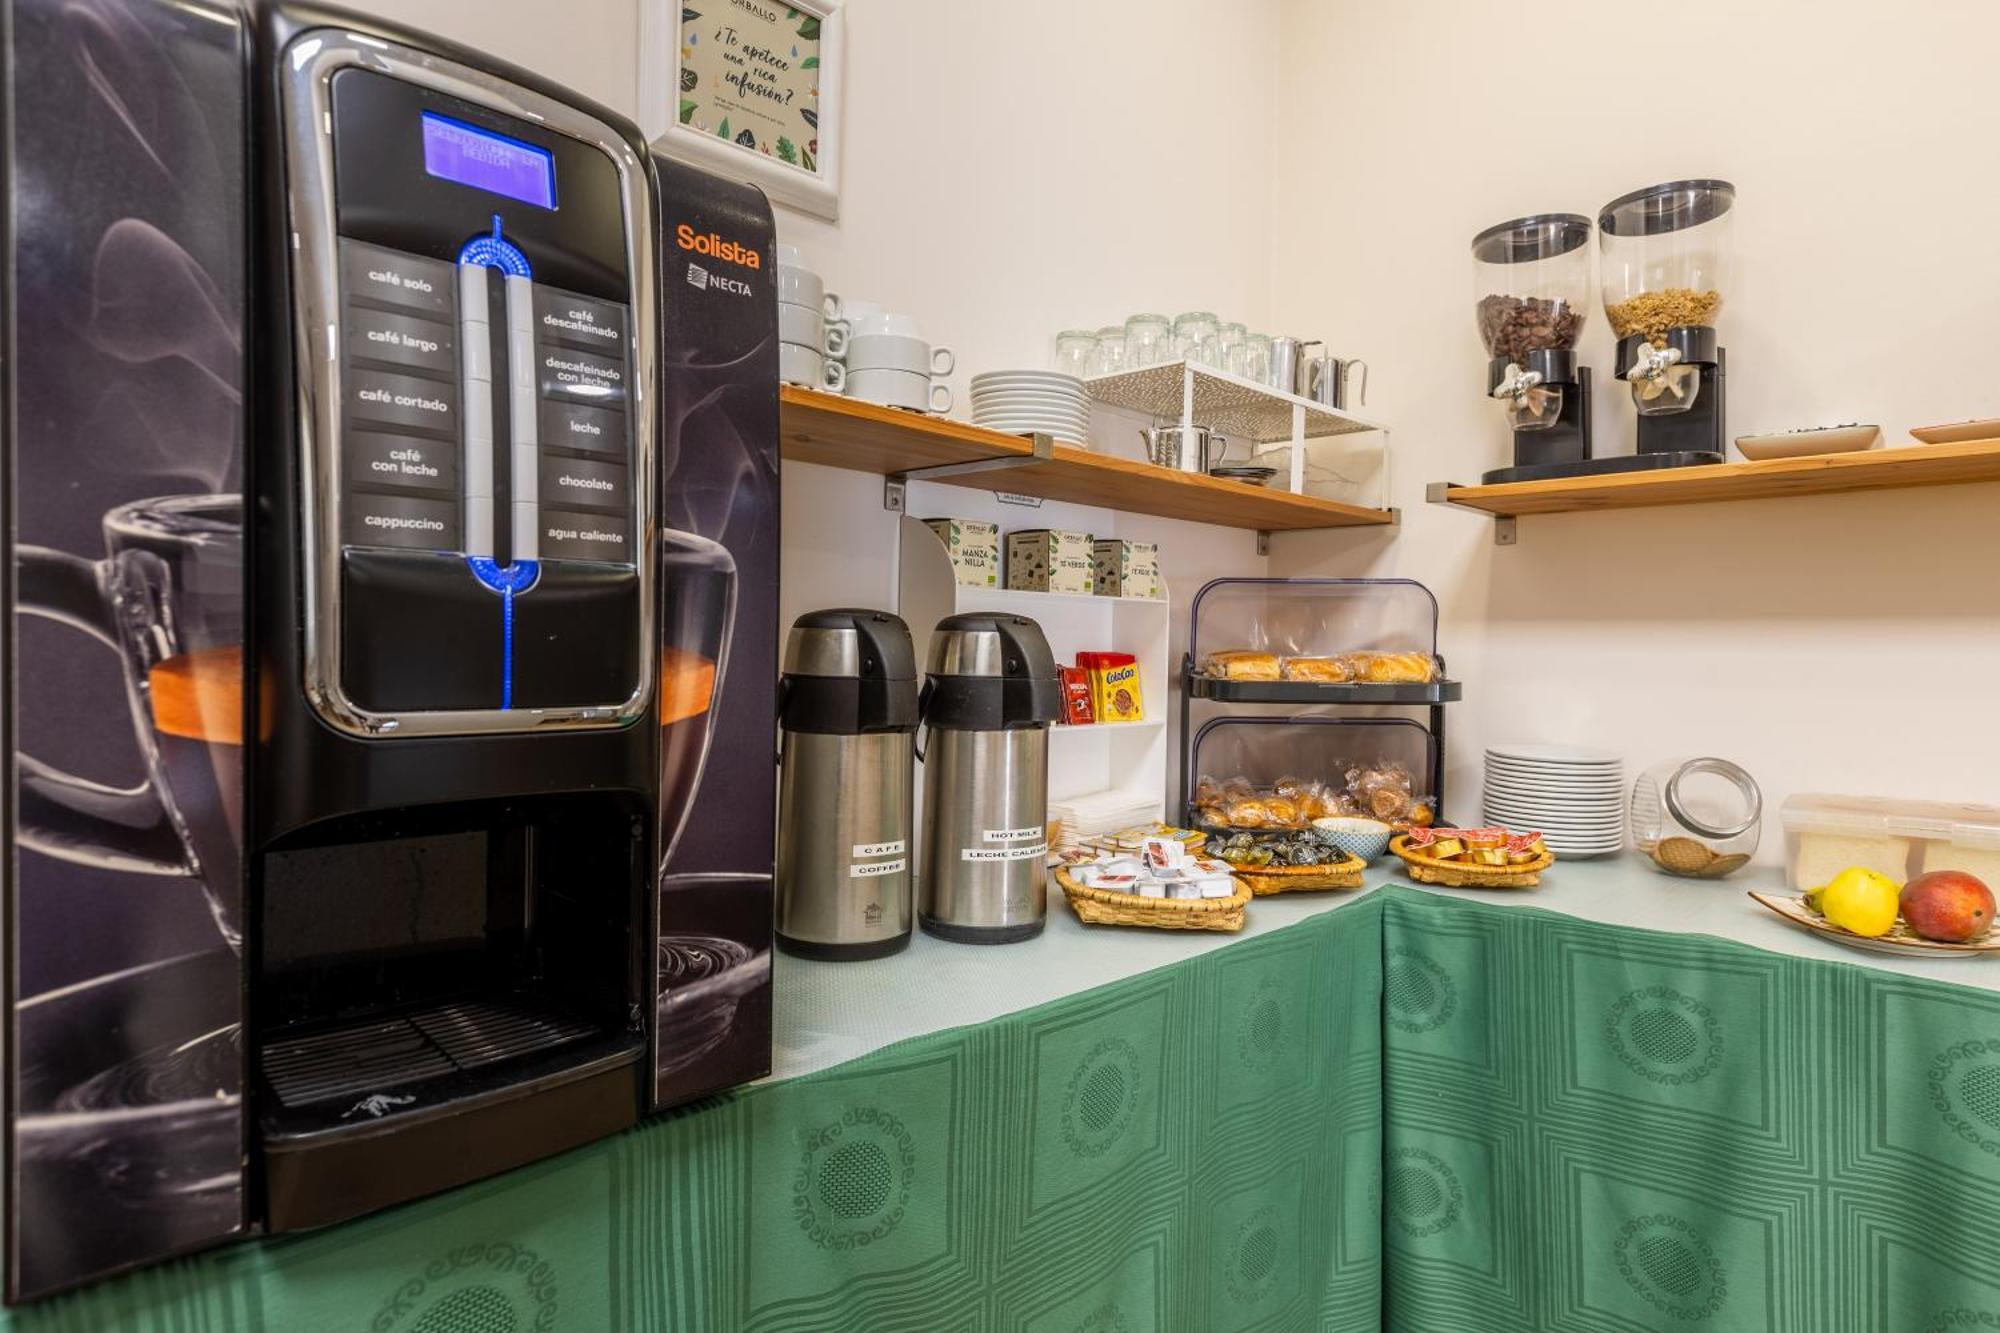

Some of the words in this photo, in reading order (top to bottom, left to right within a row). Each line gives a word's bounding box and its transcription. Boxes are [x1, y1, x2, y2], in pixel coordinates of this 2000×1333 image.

[715, 26, 738, 46] ¿Te
[743, 45, 788, 71] apetece
[724, 52, 745, 65] una
[753, 68, 777, 83] rica
[725, 71, 794, 105] infusión?
[677, 224, 760, 269] Solista
[369, 269, 400, 286] café
[403, 278, 432, 293] solo
[710, 274, 752, 297] NECTA
[569, 308, 593, 322] café
[544, 313, 618, 339] descafeinado
[368, 329, 400, 344] café
[403, 336, 438, 352] largo
[546, 357, 620, 380] descafeinado
[557, 371, 578, 381] con
[581, 374, 610, 388] leche
[359, 389, 392, 404] café
[395, 395, 447, 413] cortado
[570, 421, 600, 435] leche
[389, 448, 421, 462] café
[372, 460, 398, 471] con
[402, 460, 438, 477] leche
[559, 474, 613, 491] chocolate
[365, 513, 444, 531] cappuccino
[548, 528, 577, 540] agua
[580, 529, 623, 543] caliente
[962, 548, 988, 558] MANZA
[965, 558, 985, 567] NILLA
[1012, 847, 1046, 856] CALIENT
[859, 863, 900, 873] COFFEE
